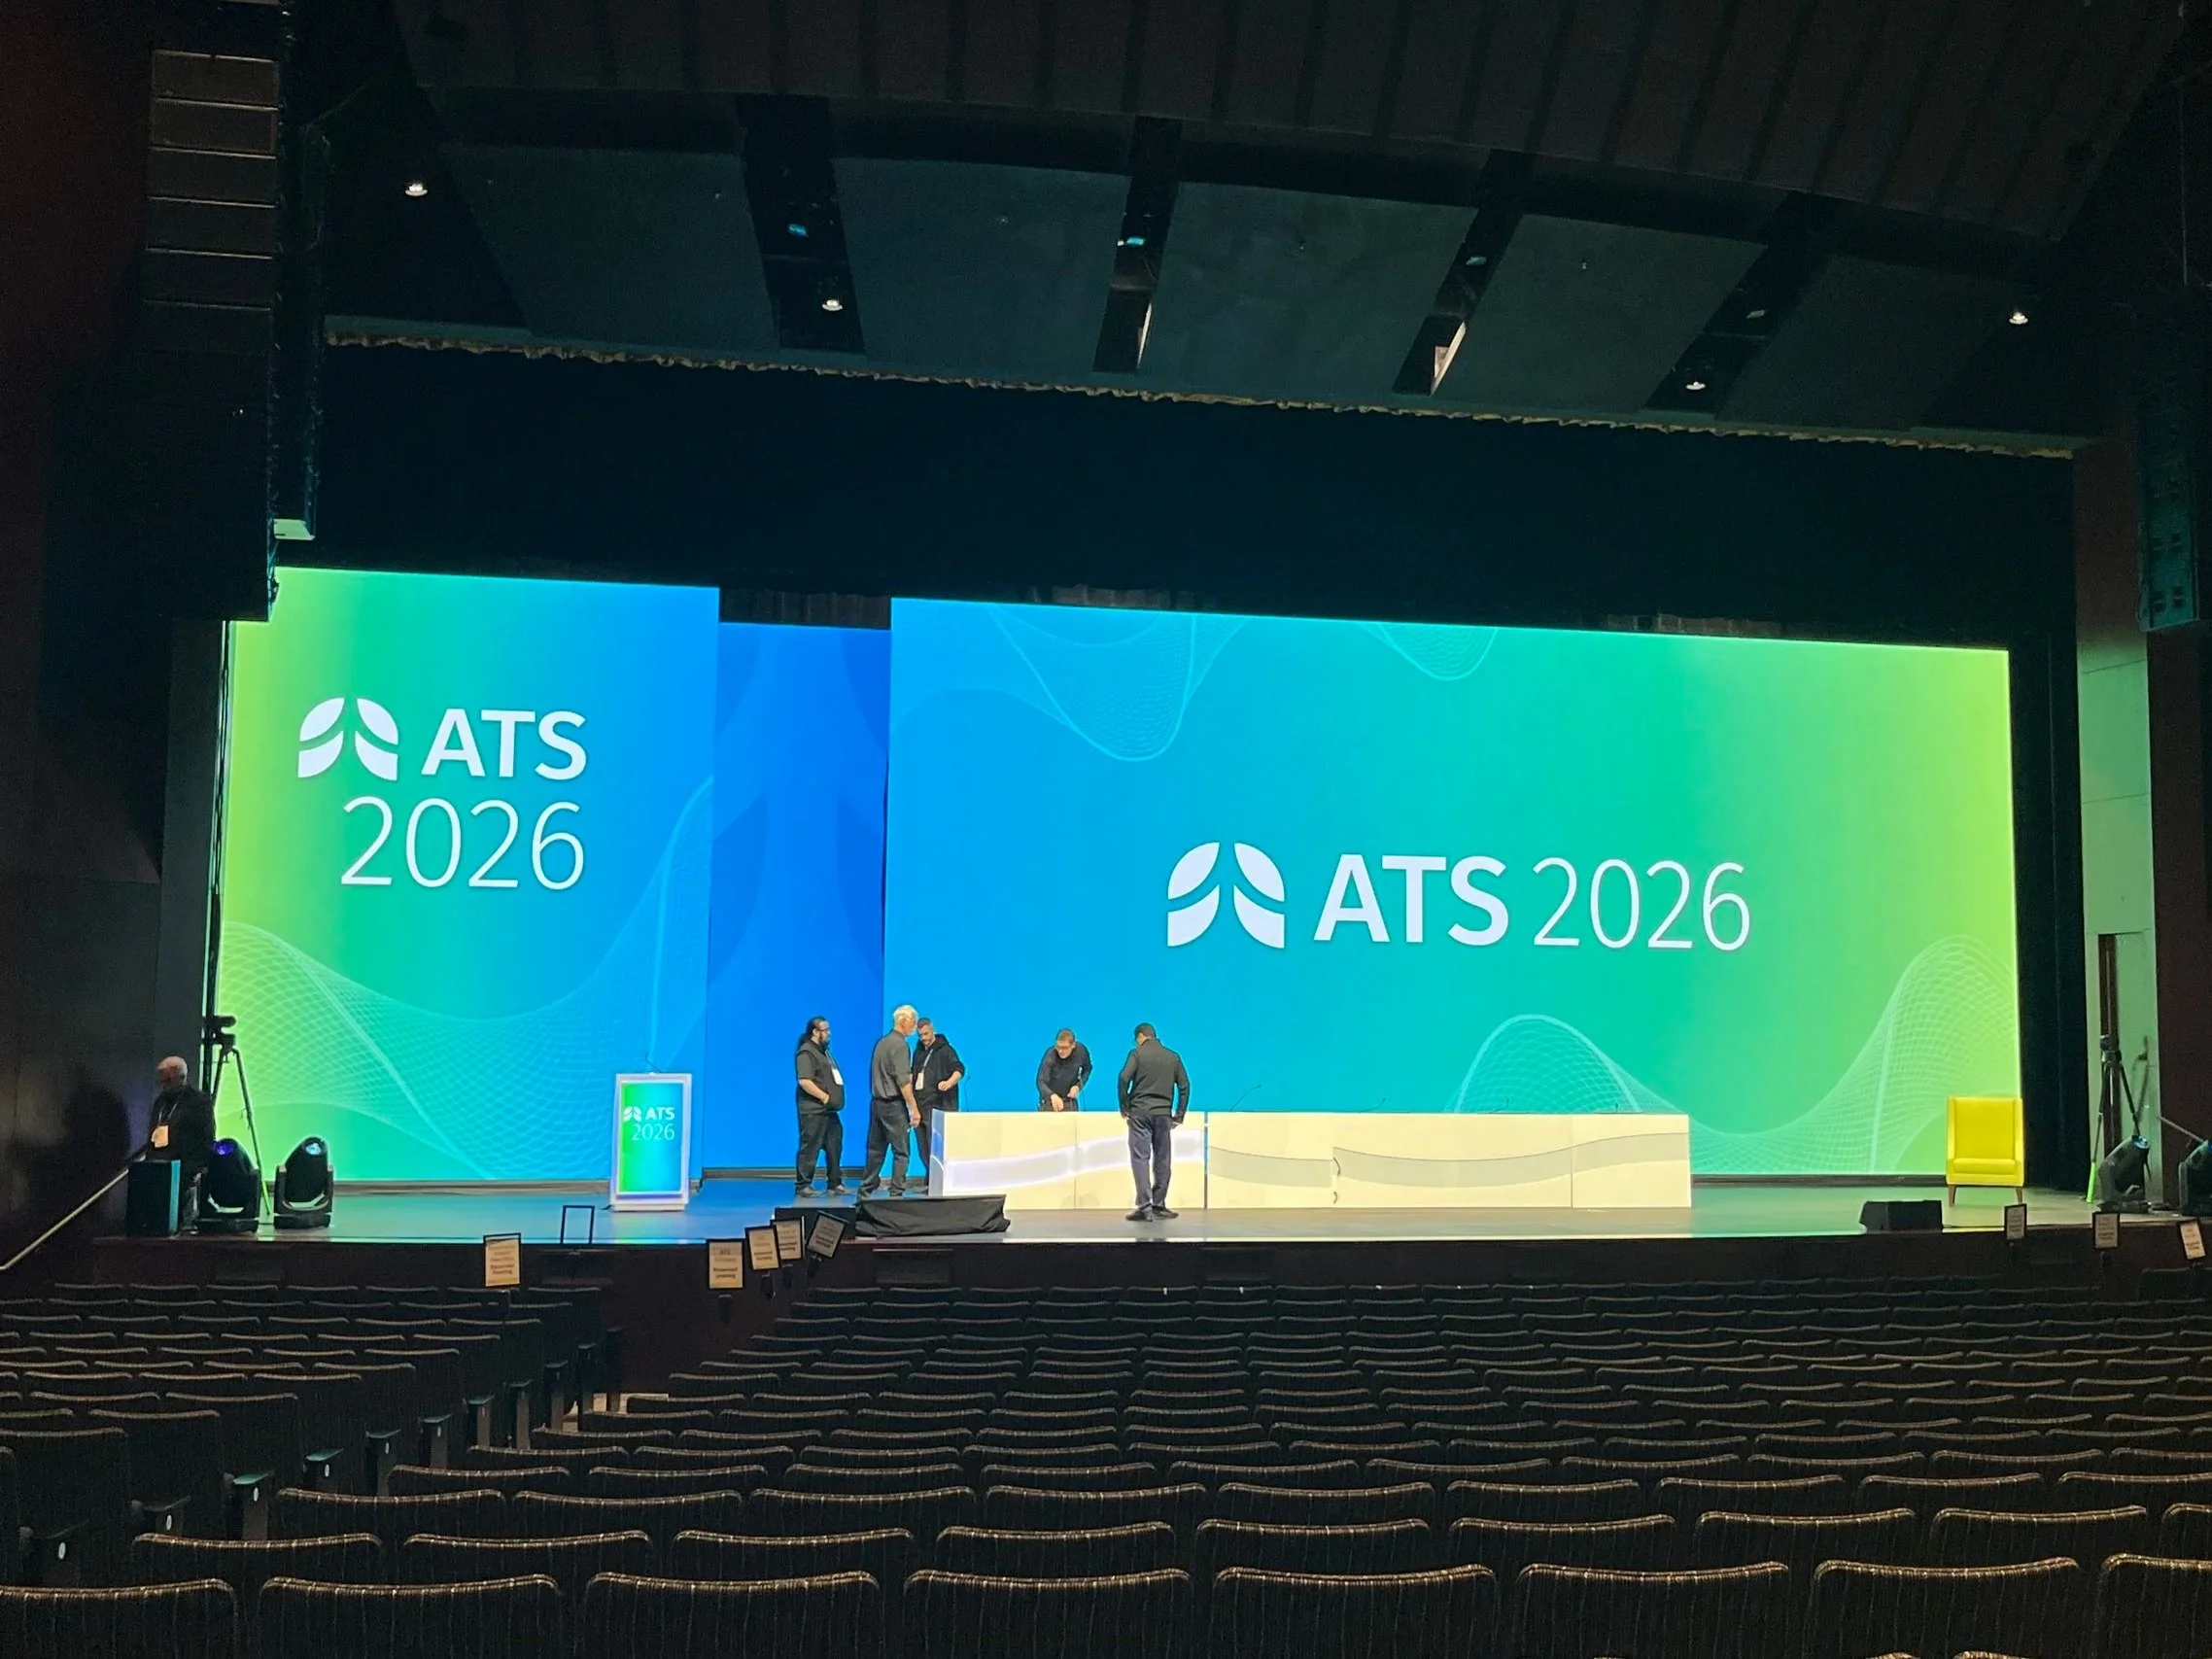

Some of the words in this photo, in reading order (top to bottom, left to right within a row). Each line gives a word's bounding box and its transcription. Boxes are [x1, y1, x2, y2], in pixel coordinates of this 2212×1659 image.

[422, 709, 586, 779] ATS
[341, 796, 584, 889] 2026
[1314, 854, 1508, 946] ATS
[1534, 857, 1750, 950] 2026
[631, 1123, 675, 1141] 2026
[644, 1106, 675, 1121] ATS
